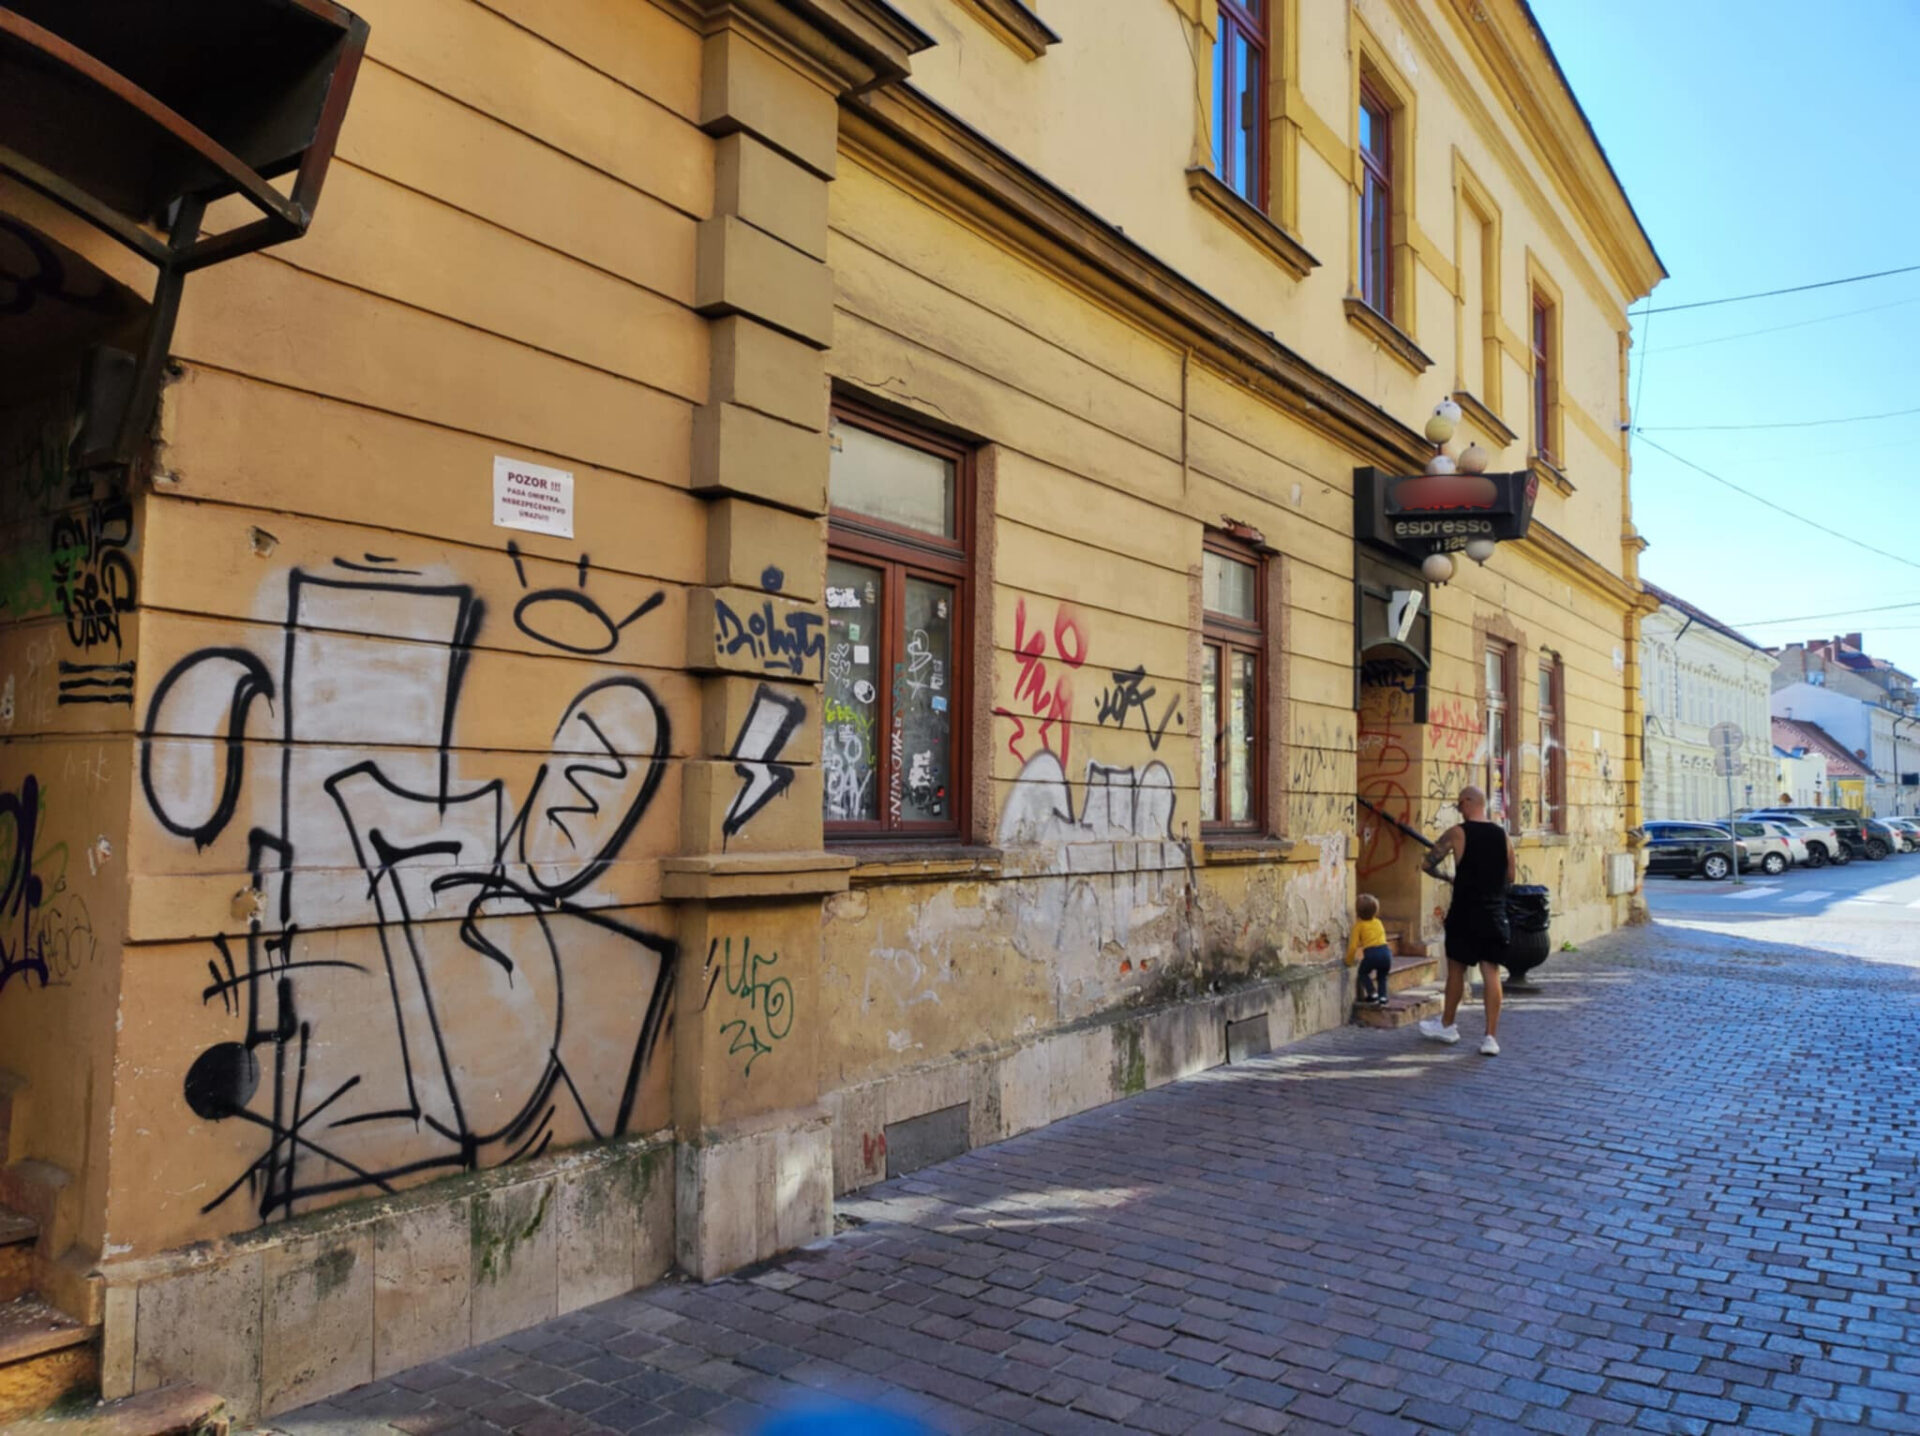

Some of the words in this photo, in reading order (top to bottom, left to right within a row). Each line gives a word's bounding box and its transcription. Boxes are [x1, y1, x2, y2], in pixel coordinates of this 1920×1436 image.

[507, 471, 548, 490] POZOR
[501, 496, 566, 515] NEBEZPEČENSTVO
[1394, 519, 1492, 536] espresso
